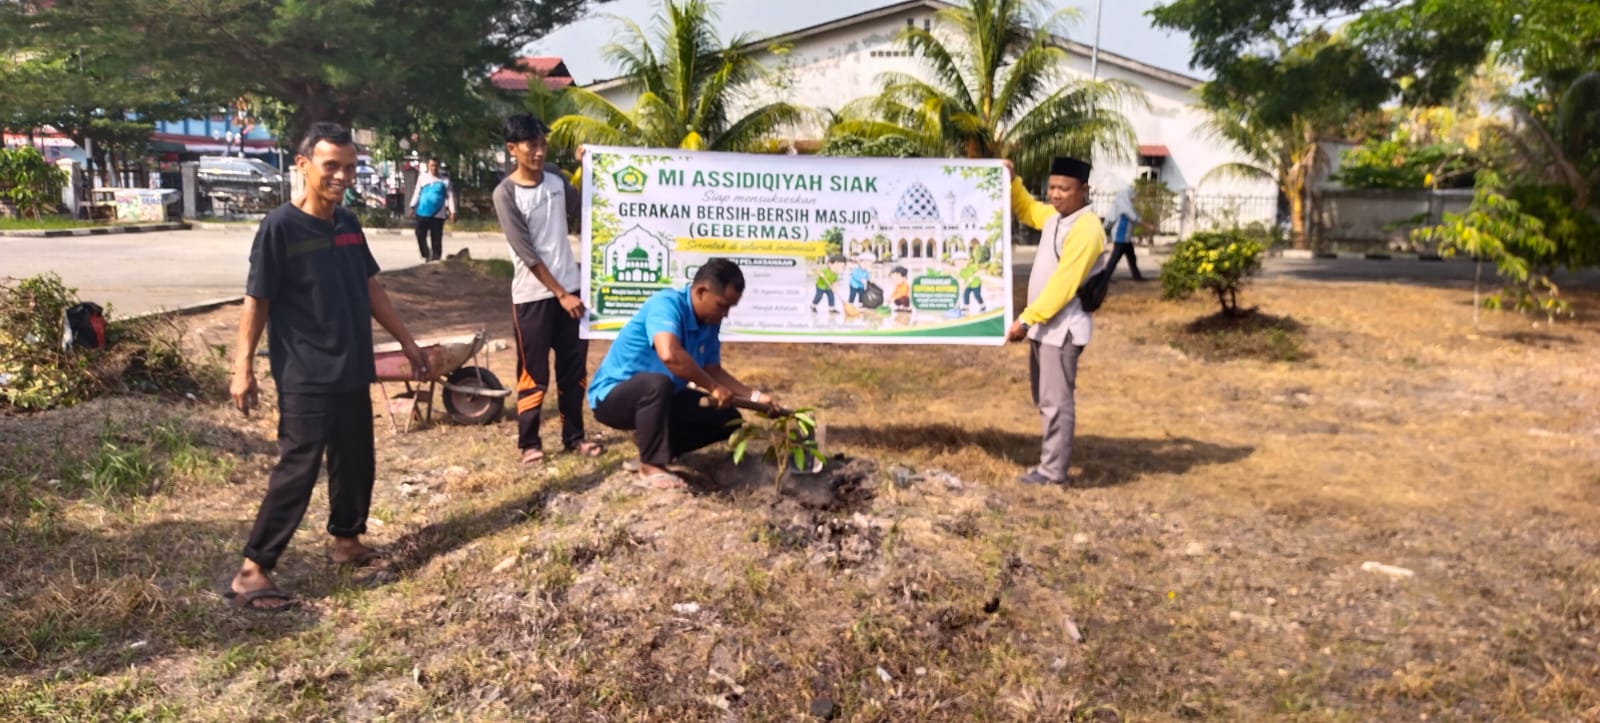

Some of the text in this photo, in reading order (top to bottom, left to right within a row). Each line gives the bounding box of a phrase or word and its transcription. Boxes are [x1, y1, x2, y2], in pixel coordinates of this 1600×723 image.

[658, 169, 879, 193] MI ASSIDIQIYAH SIAK
[702, 190, 817, 205] Siap mensukseskan
[619, 202, 871, 225] GERAKAN BERSIH-BERSIH MASJID
[689, 222, 809, 241] (GEBERMAS)
[740, 258, 794, 267] PELAKSANAAN
